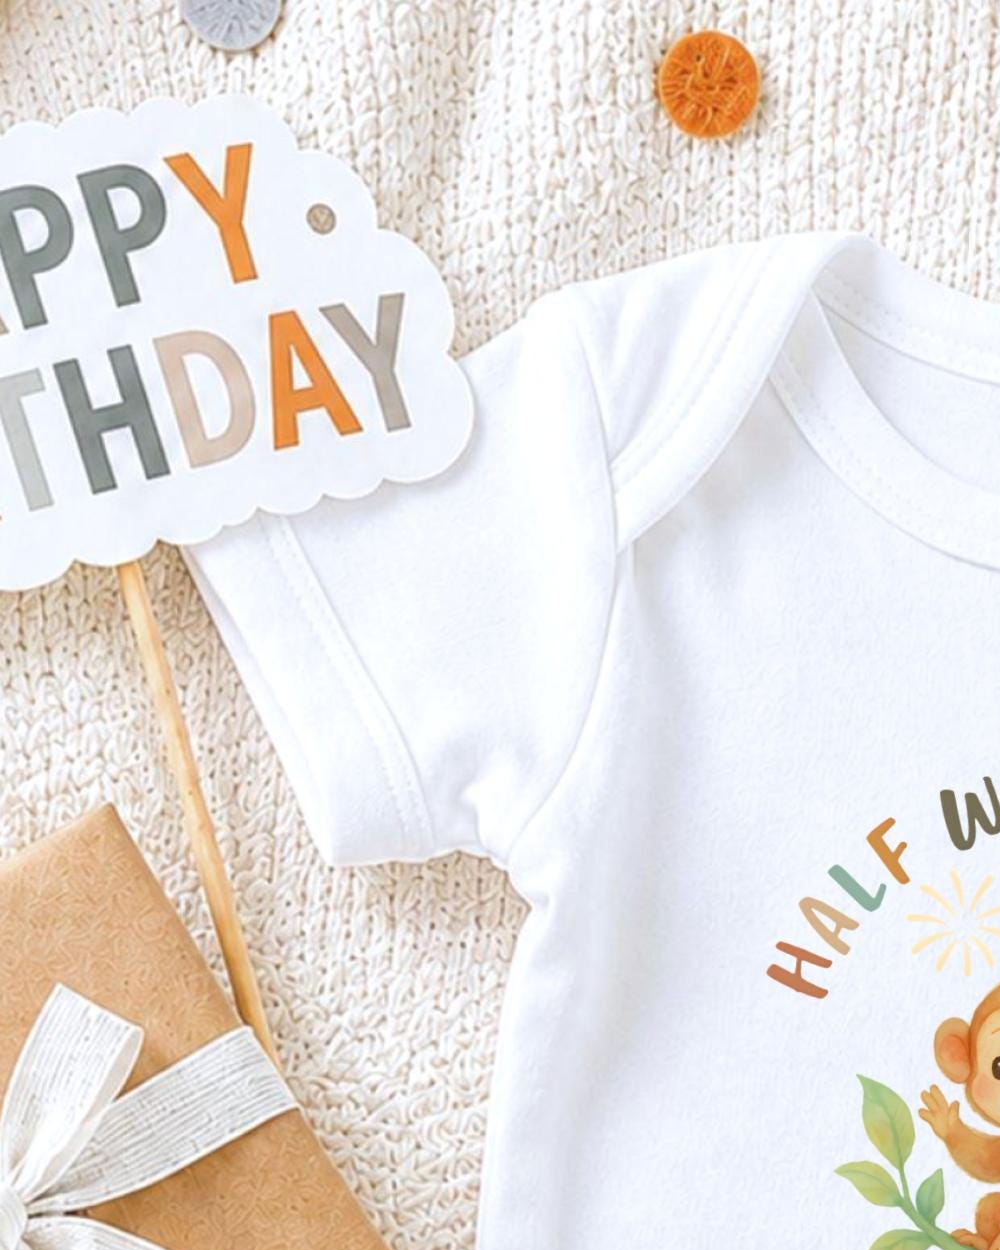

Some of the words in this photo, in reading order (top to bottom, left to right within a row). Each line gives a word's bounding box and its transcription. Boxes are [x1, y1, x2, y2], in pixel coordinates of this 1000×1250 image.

[0, 142, 259, 335] PPY
[0, 292, 412, 512] THDAY
[766, 817, 910, 999] HALF
